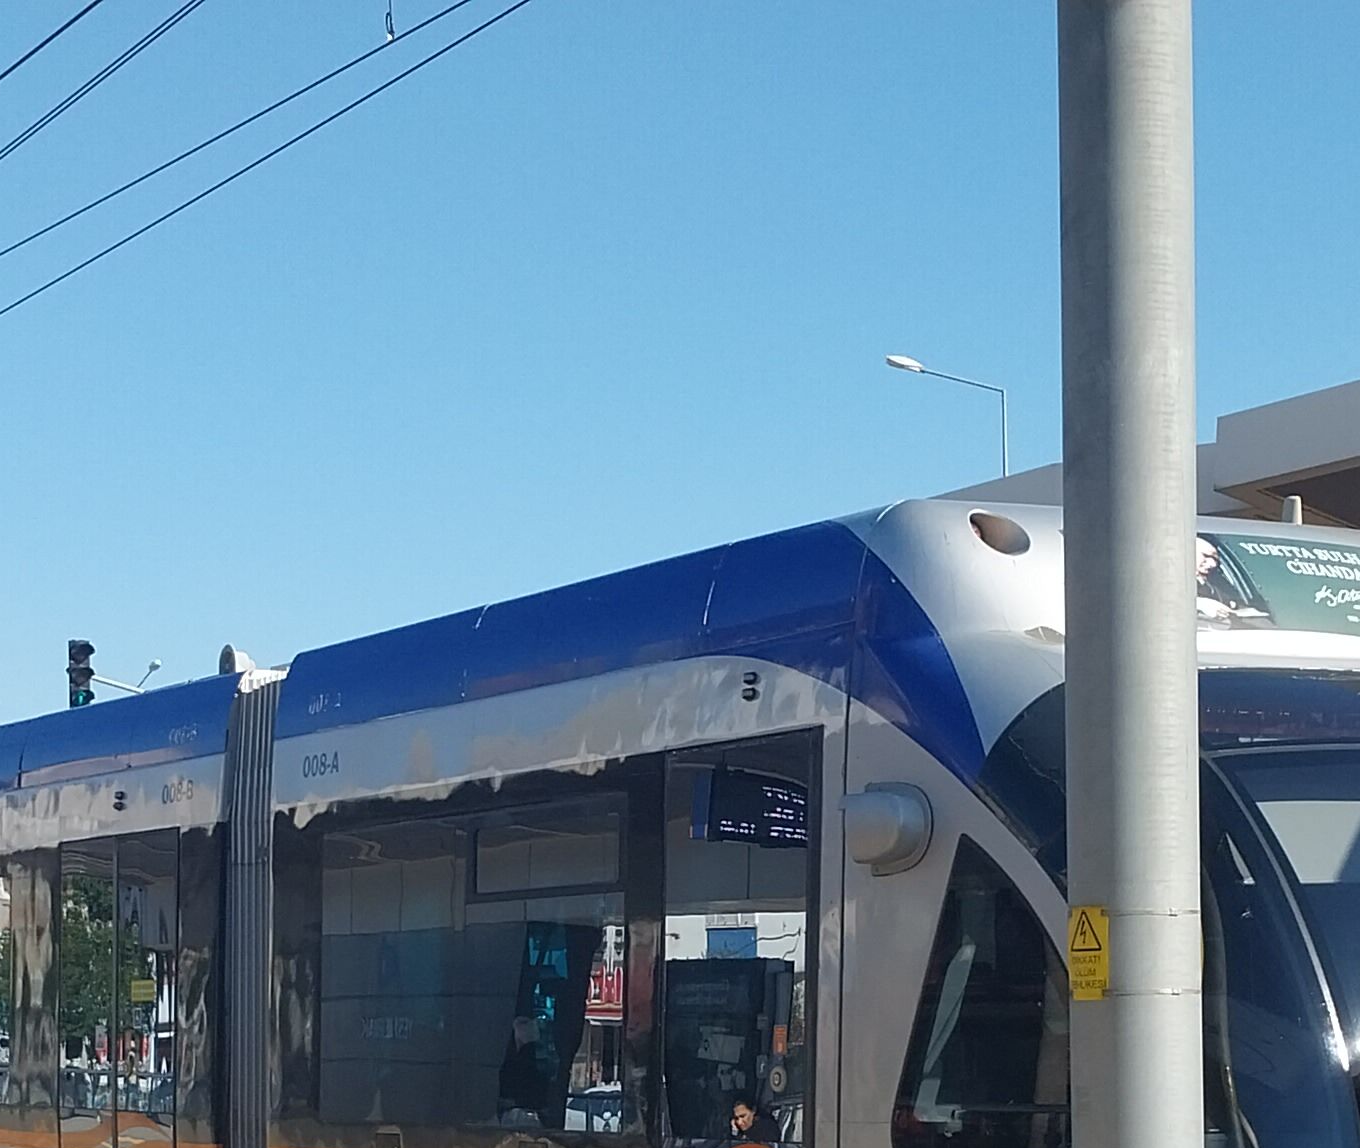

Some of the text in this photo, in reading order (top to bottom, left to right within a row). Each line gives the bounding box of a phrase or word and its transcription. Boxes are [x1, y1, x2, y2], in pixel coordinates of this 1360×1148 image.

[1240, 542, 1314, 560] YURTTA
[303, 751, 339, 778] 008-A
[162, 779, 194, 804] 008-B
